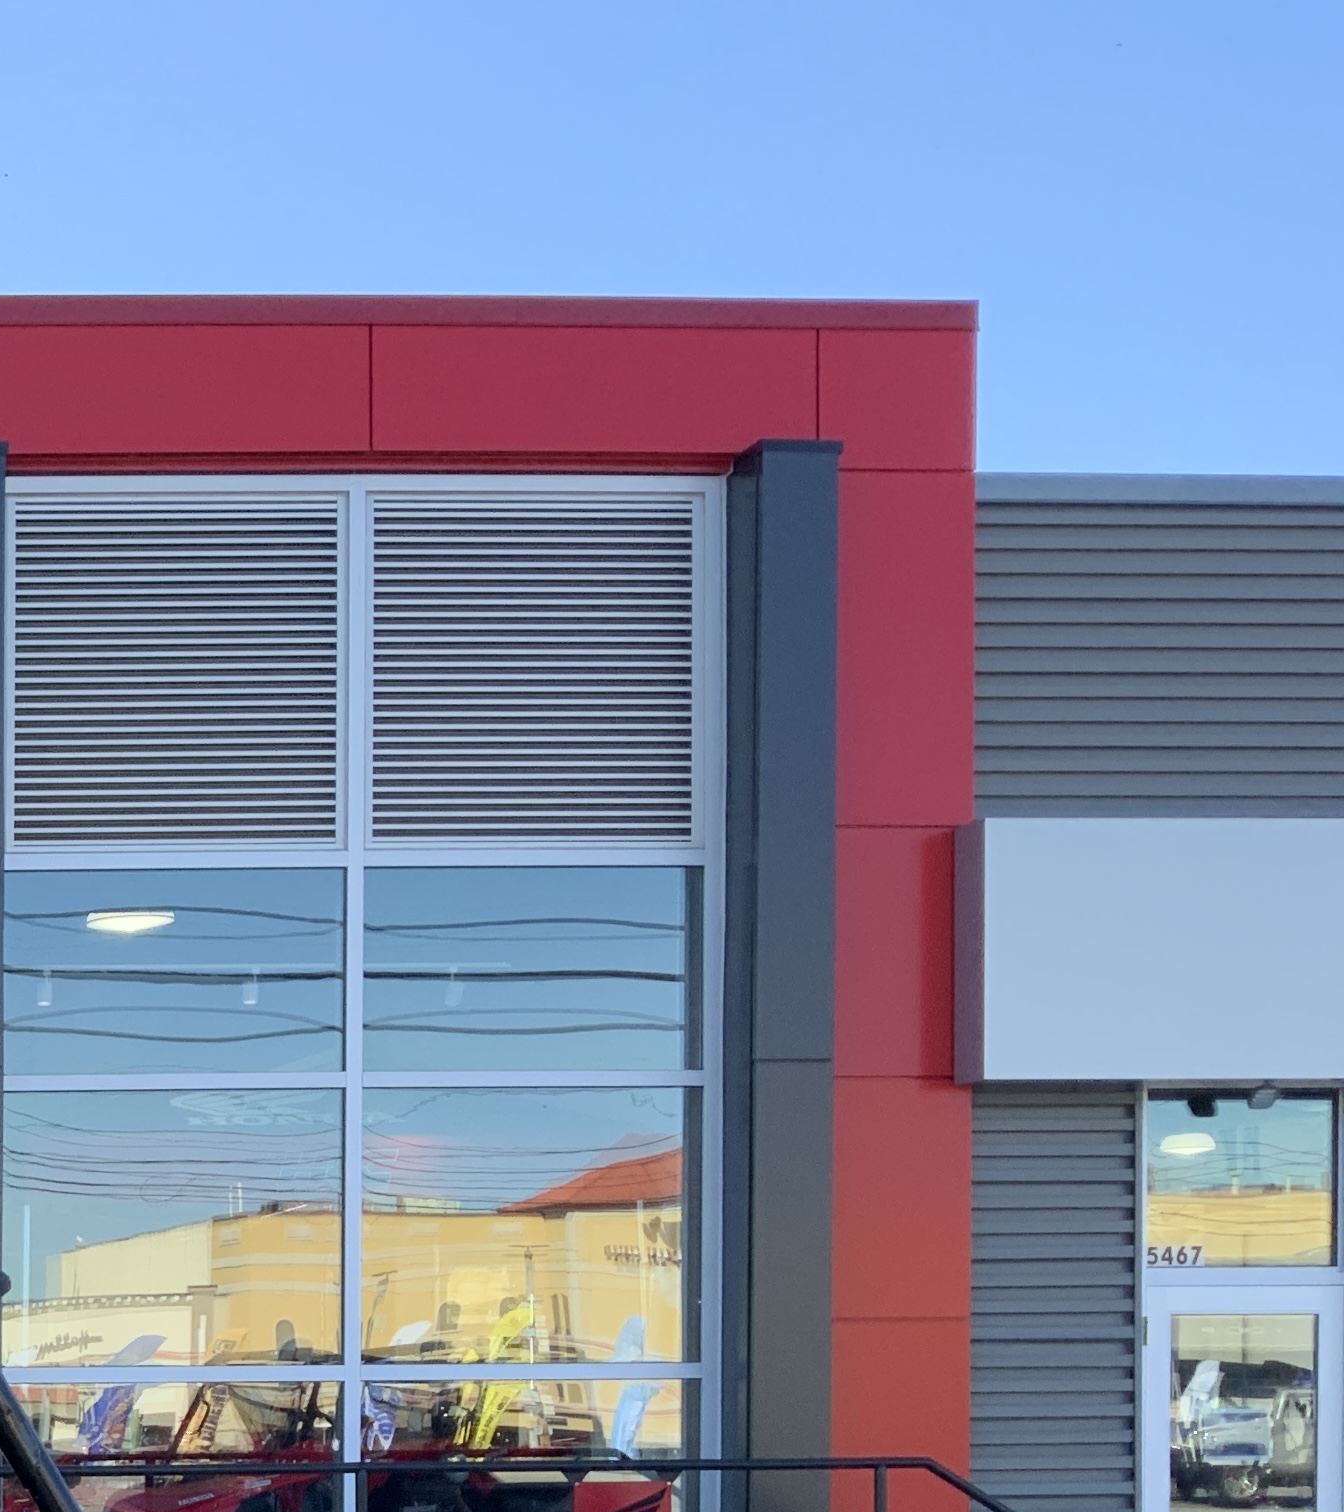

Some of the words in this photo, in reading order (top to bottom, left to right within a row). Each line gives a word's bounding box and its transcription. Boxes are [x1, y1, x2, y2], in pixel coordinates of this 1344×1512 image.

[185, 1110, 409, 1126] HONA
[1146, 1245, 1203, 1265] 5467
[178, 1492, 215, 1506] HONDA
